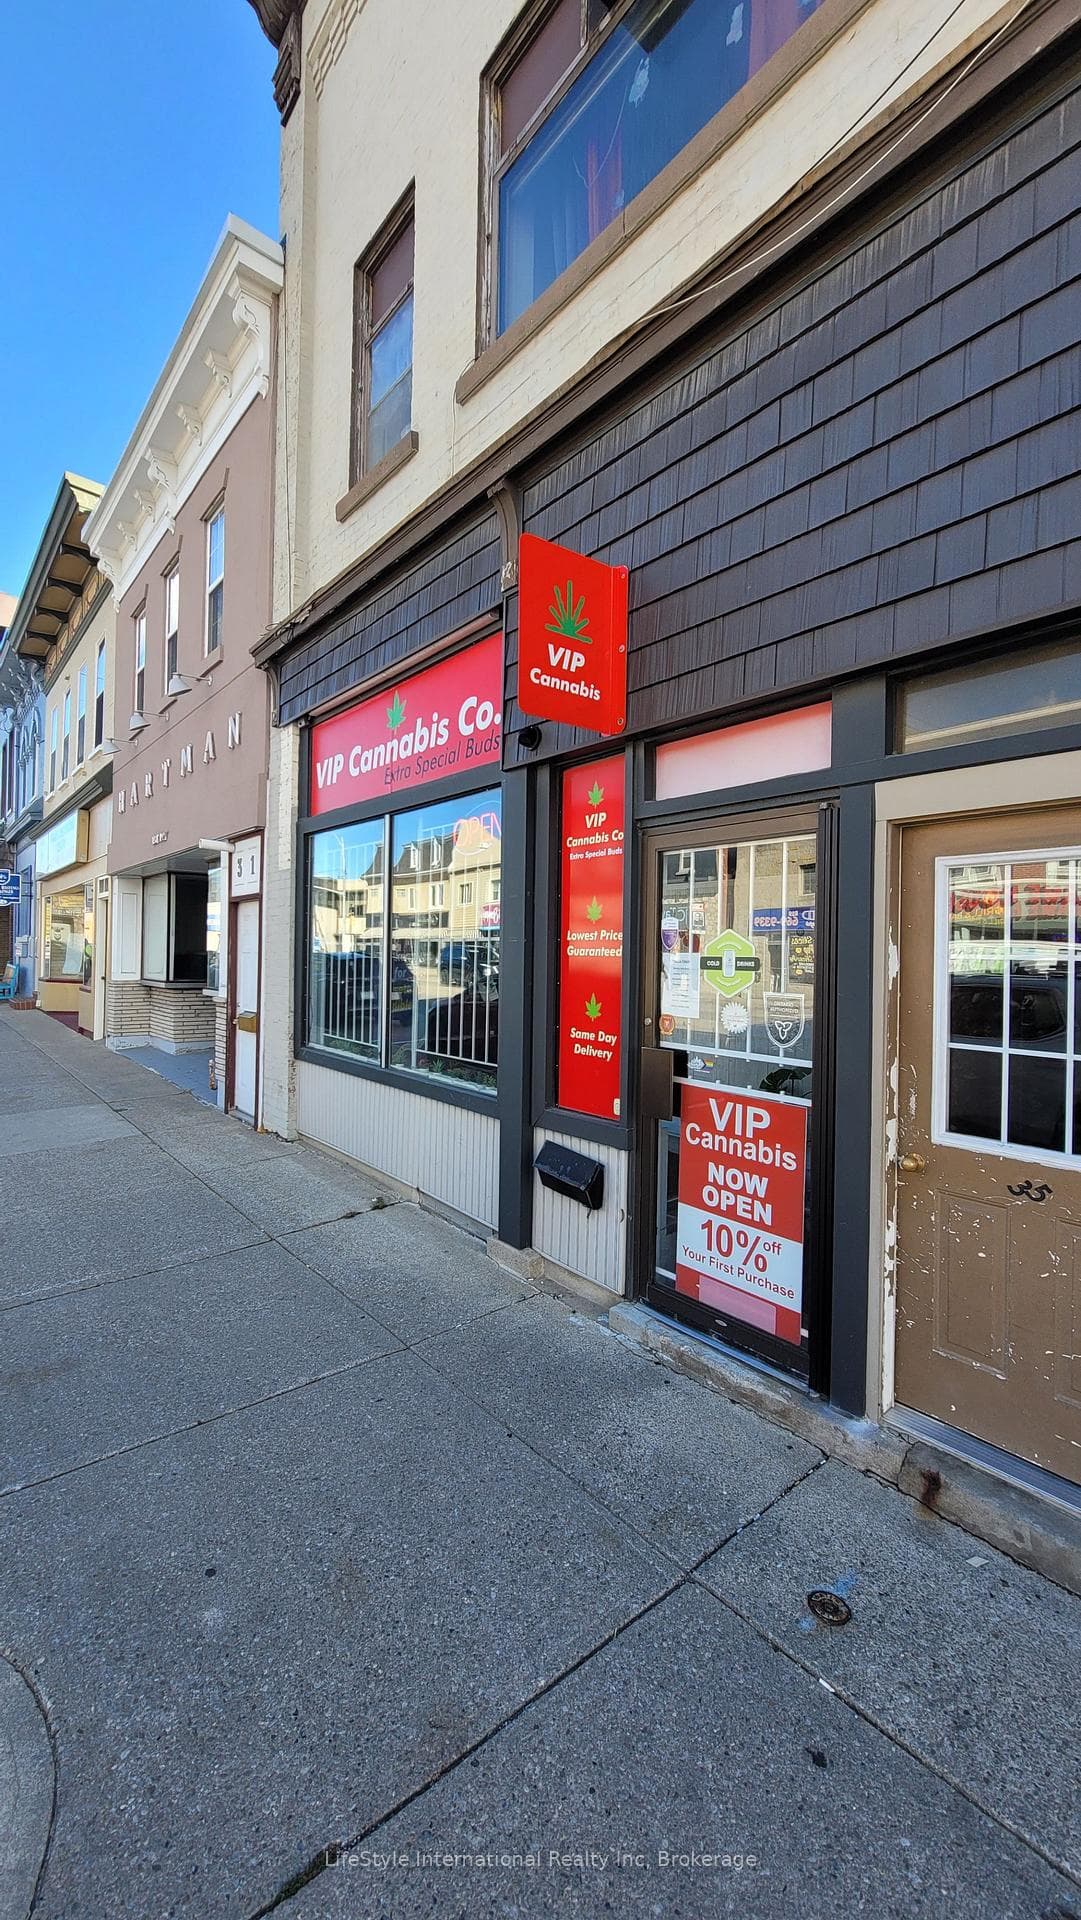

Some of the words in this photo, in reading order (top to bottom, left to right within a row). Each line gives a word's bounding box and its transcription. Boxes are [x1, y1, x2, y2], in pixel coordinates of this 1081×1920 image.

[548, 643, 586, 673] VIP
[529, 666, 601, 701] Cannabis
[316, 753, 344, 789] VIP
[349, 712, 450, 777] Cannabis
[458, 696, 501, 736] Co.
[384, 766, 411, 786] Extra
[415, 741, 461, 778] Special
[465, 729, 501, 759] Buds
[118, 710, 242, 815] HARTMAN
[584, 812, 607, 829] VIP
[566, 832, 609, 848] Cannabis
[611, 829, 624, 841] Co
[584, 848, 607, 860] Special
[607, 846, 623, 856] Buds
[566, 930, 598, 941] Lowest
[599, 929, 624, 941] Price
[566, 945, 623, 958] Guaranteed
[569, 1027, 596, 1041] Same
[597, 1030, 617, 1046] Day
[573, 1043, 613, 1062] Delivery
[708, 1098, 771, 1140] VIP
[685, 1122, 797, 1171] Cannabis
[707, 1161, 769, 1198] NOW
[1006, 1179, 1054, 1203] 35
[702, 1185, 773, 1227] OPEN
[700, 1218, 768, 1274] 10%
[763, 1240, 782, 1256] off
[681, 1244, 706, 1264] Your
[709, 1256, 734, 1276] First
[737, 1266, 796, 1300] Purchase
